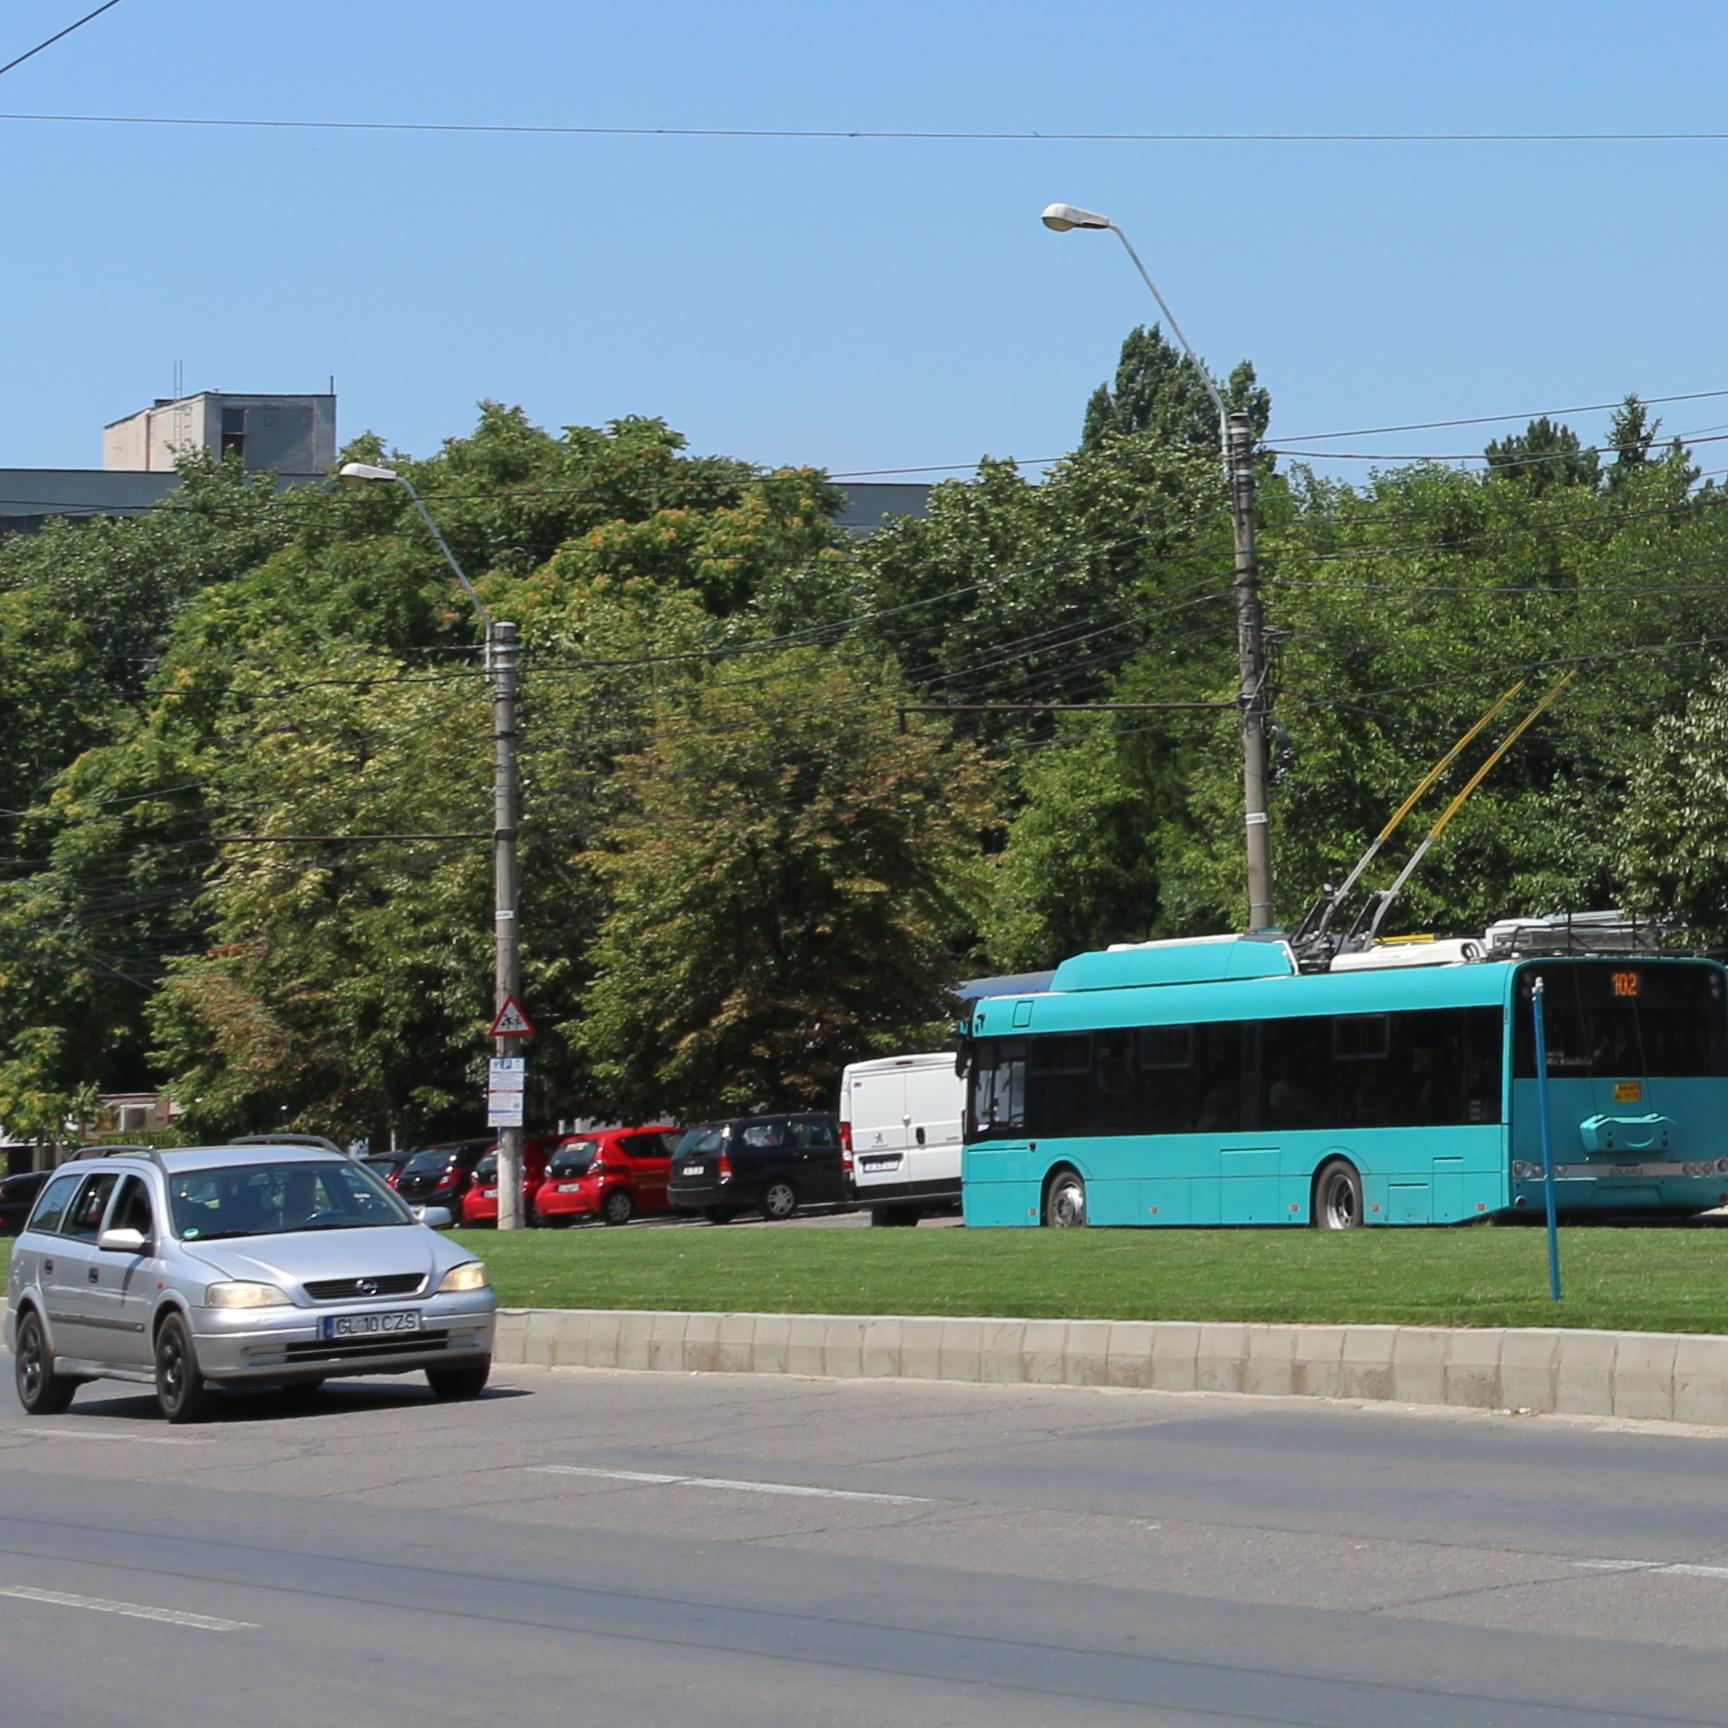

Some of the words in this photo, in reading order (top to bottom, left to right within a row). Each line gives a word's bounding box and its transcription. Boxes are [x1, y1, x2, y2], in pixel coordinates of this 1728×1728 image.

[1611, 972, 1639, 996] 102
[337, 1317, 356, 1335] GL
[363, 1315, 379, 1333] 10
[382, 1313, 416, 1332] CZS
